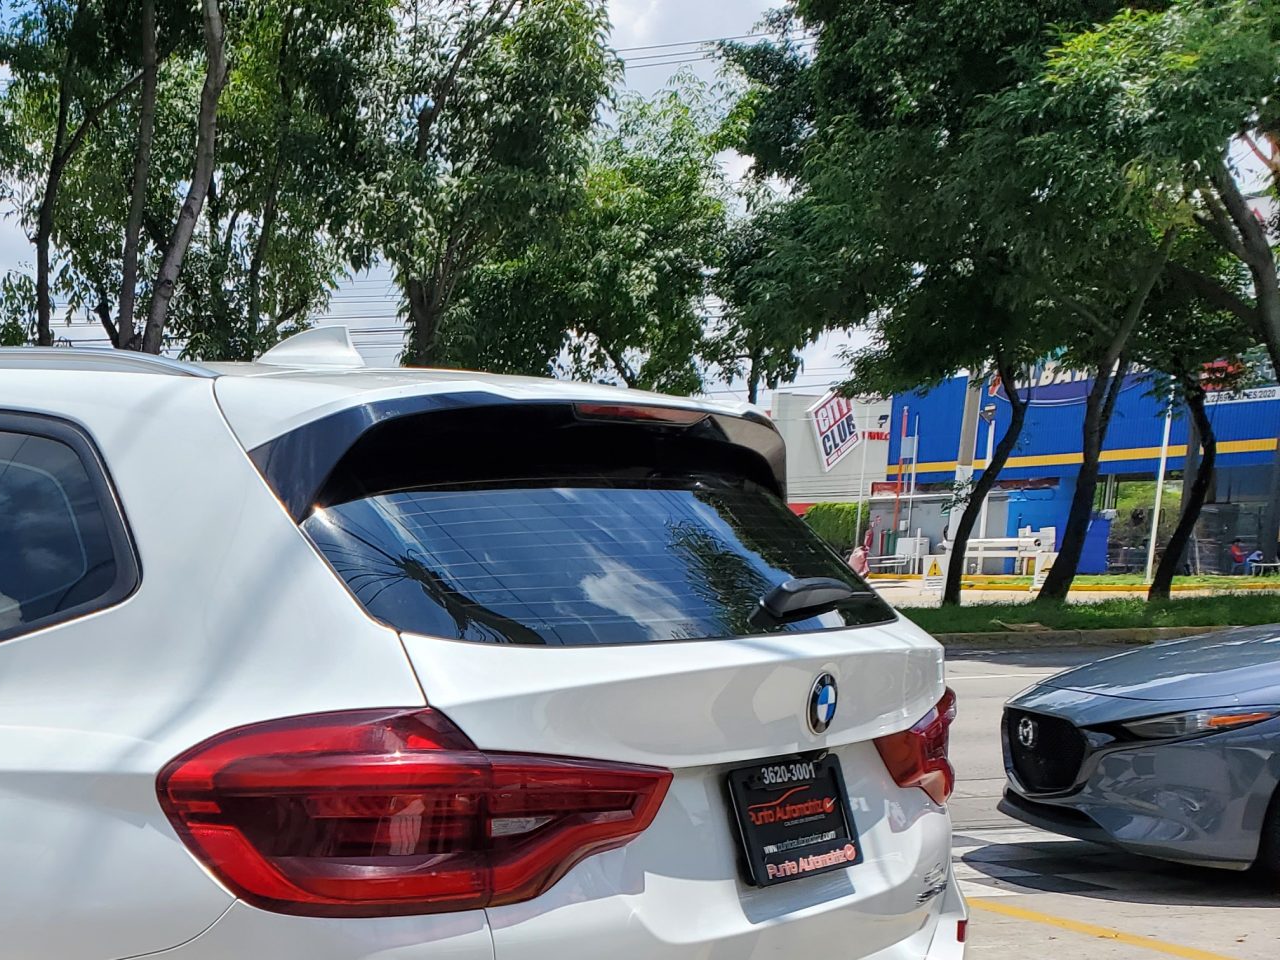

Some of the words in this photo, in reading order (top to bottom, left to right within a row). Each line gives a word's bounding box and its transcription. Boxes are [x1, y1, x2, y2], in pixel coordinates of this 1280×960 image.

[816, 397, 850, 433] CITY
[761, 762, 816, 784] 3620-3001
[765, 860, 799, 880] Punto
[799, 849, 847, 872] Automotriz
